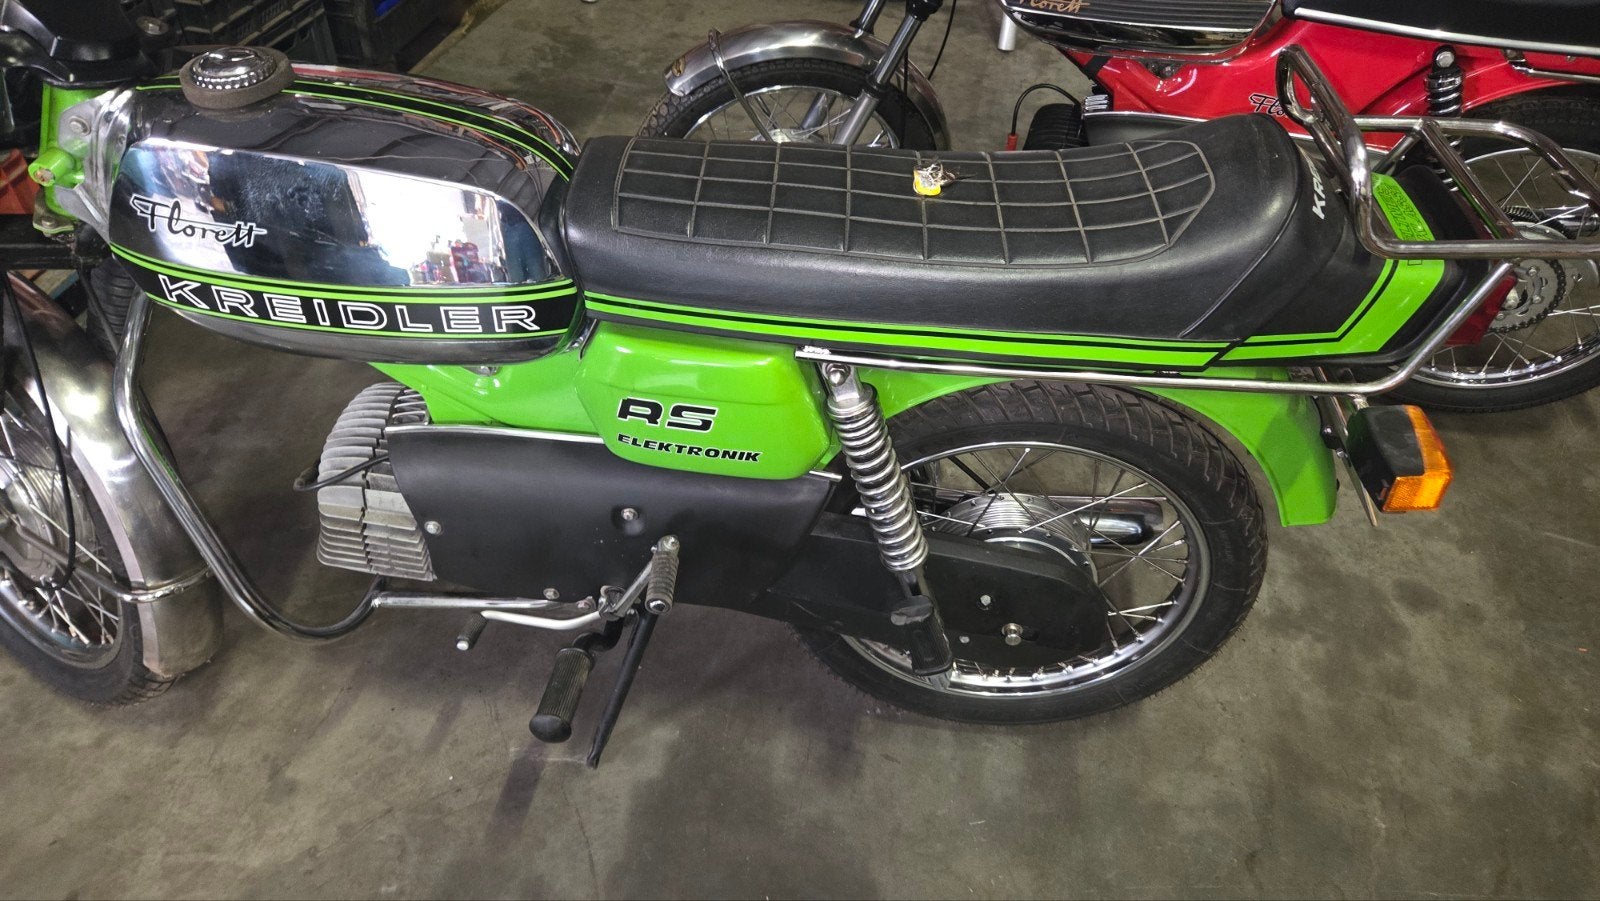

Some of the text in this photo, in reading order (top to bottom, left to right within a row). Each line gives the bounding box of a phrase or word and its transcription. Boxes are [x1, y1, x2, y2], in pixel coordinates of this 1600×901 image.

[1249, 93, 1286, 116] Flo
[130, 193, 267, 248] Florett
[158, 275, 541, 332] KREIDLER
[617, 397, 718, 433] RS
[617, 433, 762, 462] ELEKTRONIK
